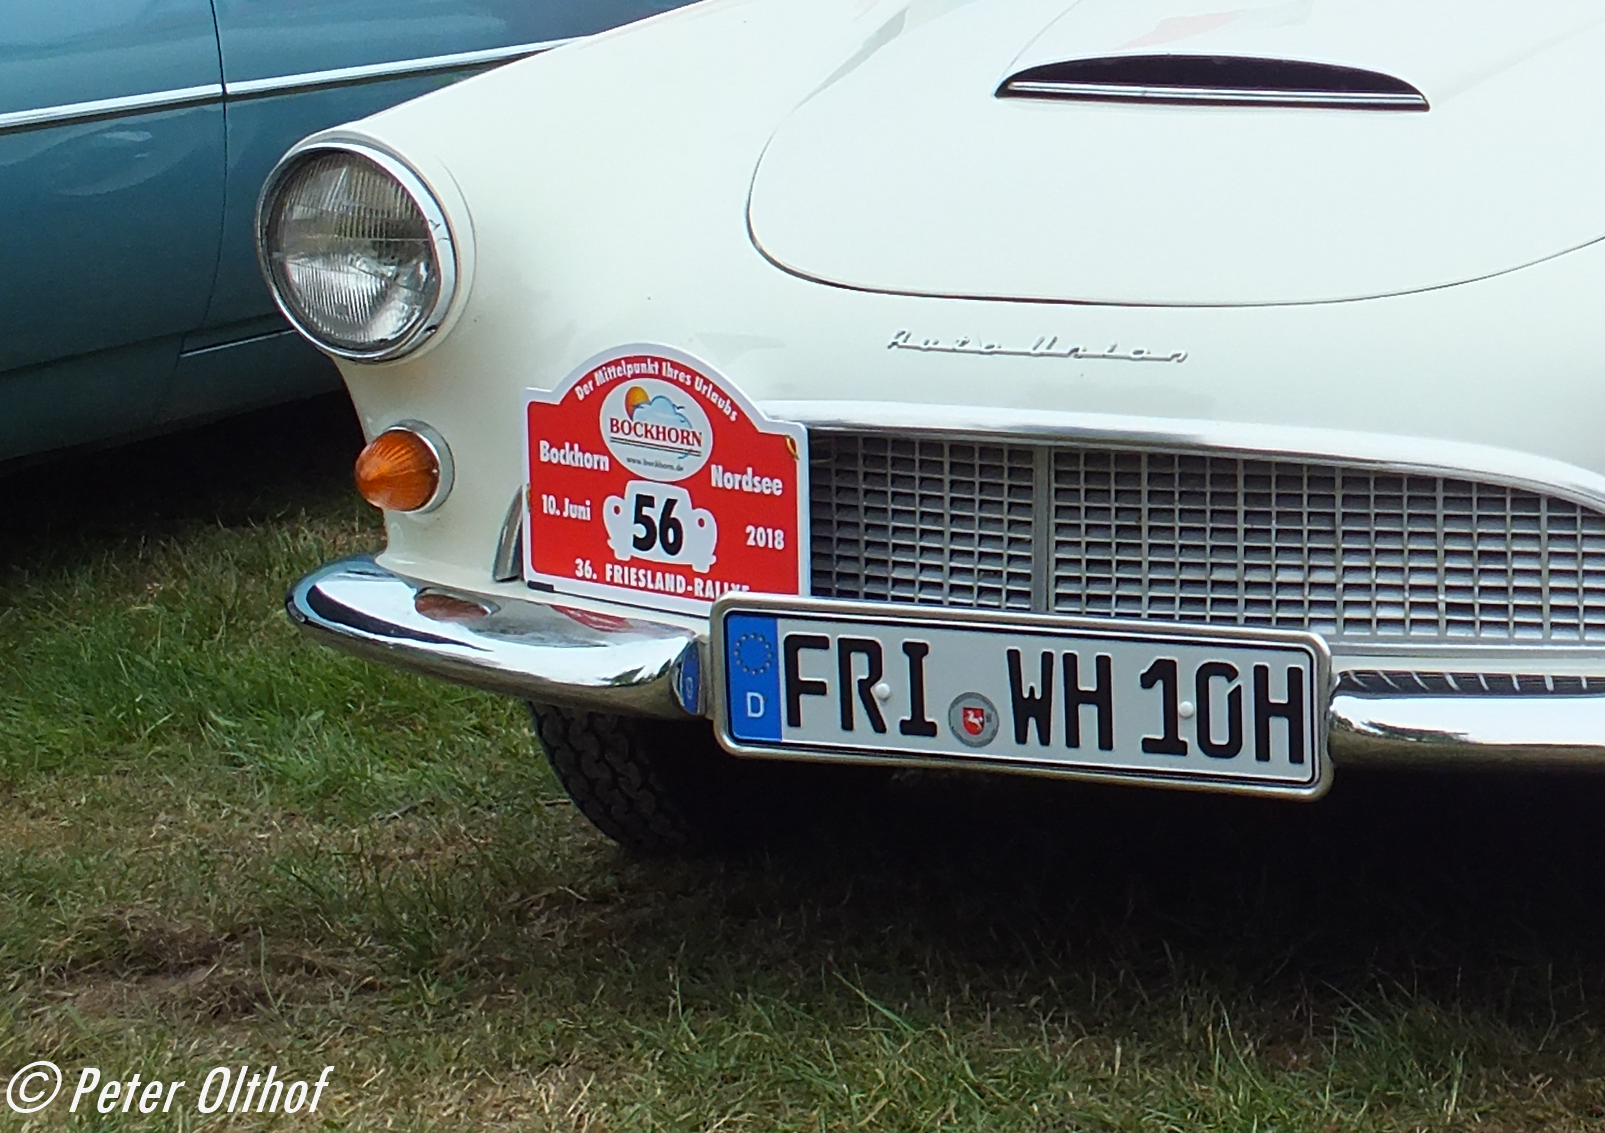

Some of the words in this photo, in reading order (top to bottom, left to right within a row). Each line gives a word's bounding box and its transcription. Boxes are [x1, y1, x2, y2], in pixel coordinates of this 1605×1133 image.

[575, 380, 594, 401] Der
[594, 358, 660, 386] Mittelpunkt
[662, 361, 692, 386] Ihres
[694, 374, 738, 422] Urlaubs
[610, 417, 703, 447] BOCKHORN
[540, 439, 610, 472] Bockhorn
[711, 464, 783, 496] Nordsee
[542, 494, 561, 516] 10.
[562, 497, 591, 521] Juni
[632, 493, 685, 557] 56
[745, 525, 785, 551] 2018
[575, 558, 598, 580] 36.
[747, 692, 765, 717] D
[783, 632, 938, 737] FRI
[1006, 647, 1114, 751] WH
[1140, 657, 1305, 765] 10H
